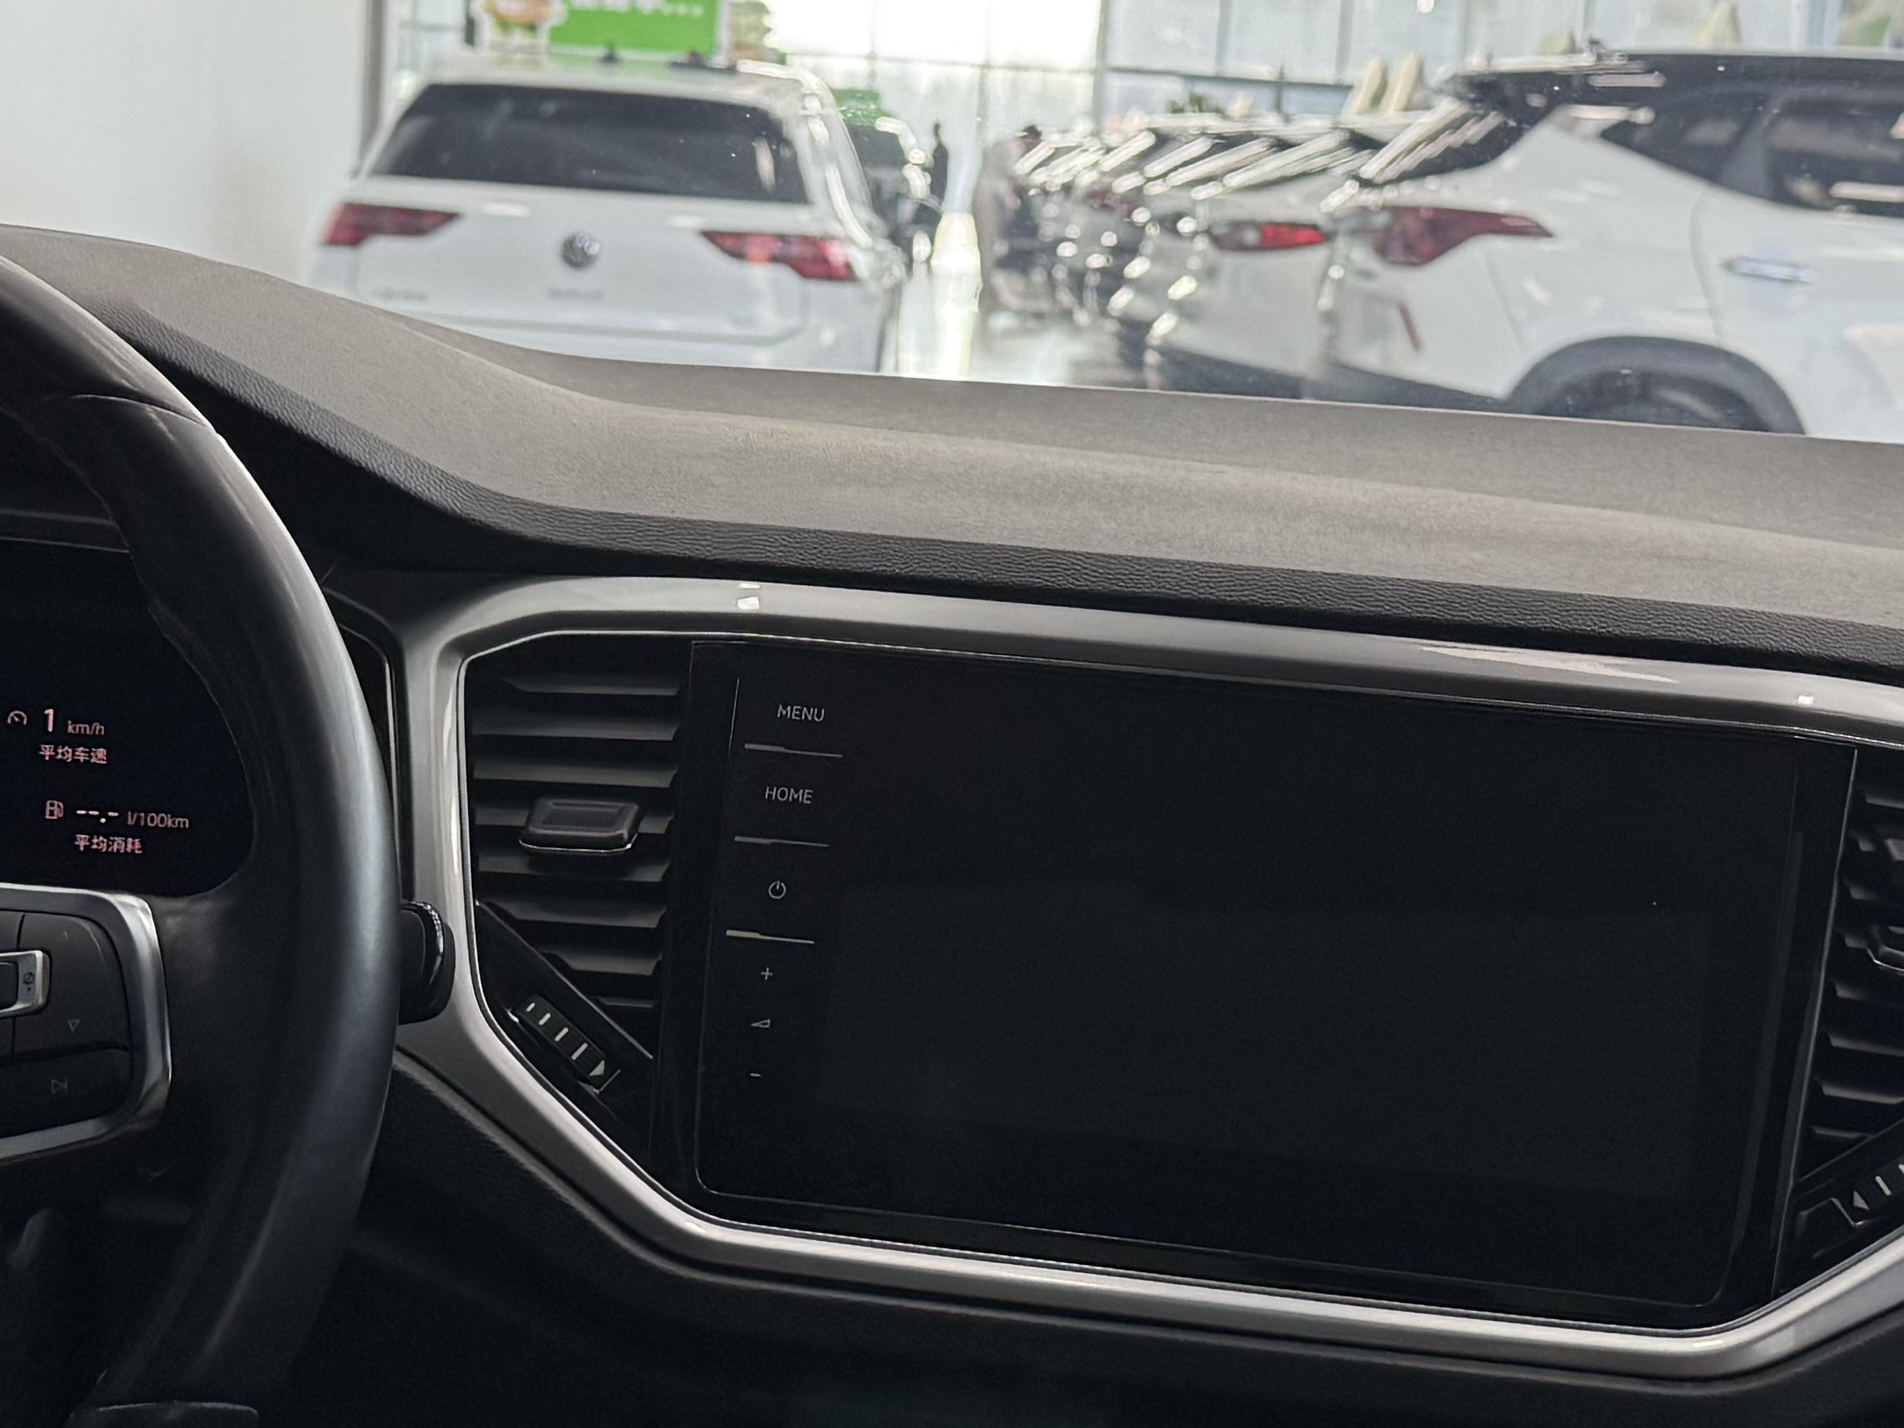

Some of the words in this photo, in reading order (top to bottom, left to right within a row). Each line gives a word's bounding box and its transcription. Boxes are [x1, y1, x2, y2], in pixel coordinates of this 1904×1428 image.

[44, 708, 55, 733] 1
[67, 720, 105, 736] km/h
[776, 704, 825, 723] MENU
[39, 744, 109, 764] 平均车速
[765, 786, 814, 805] HOME
[74, 833, 143, 854] 平均消耗
